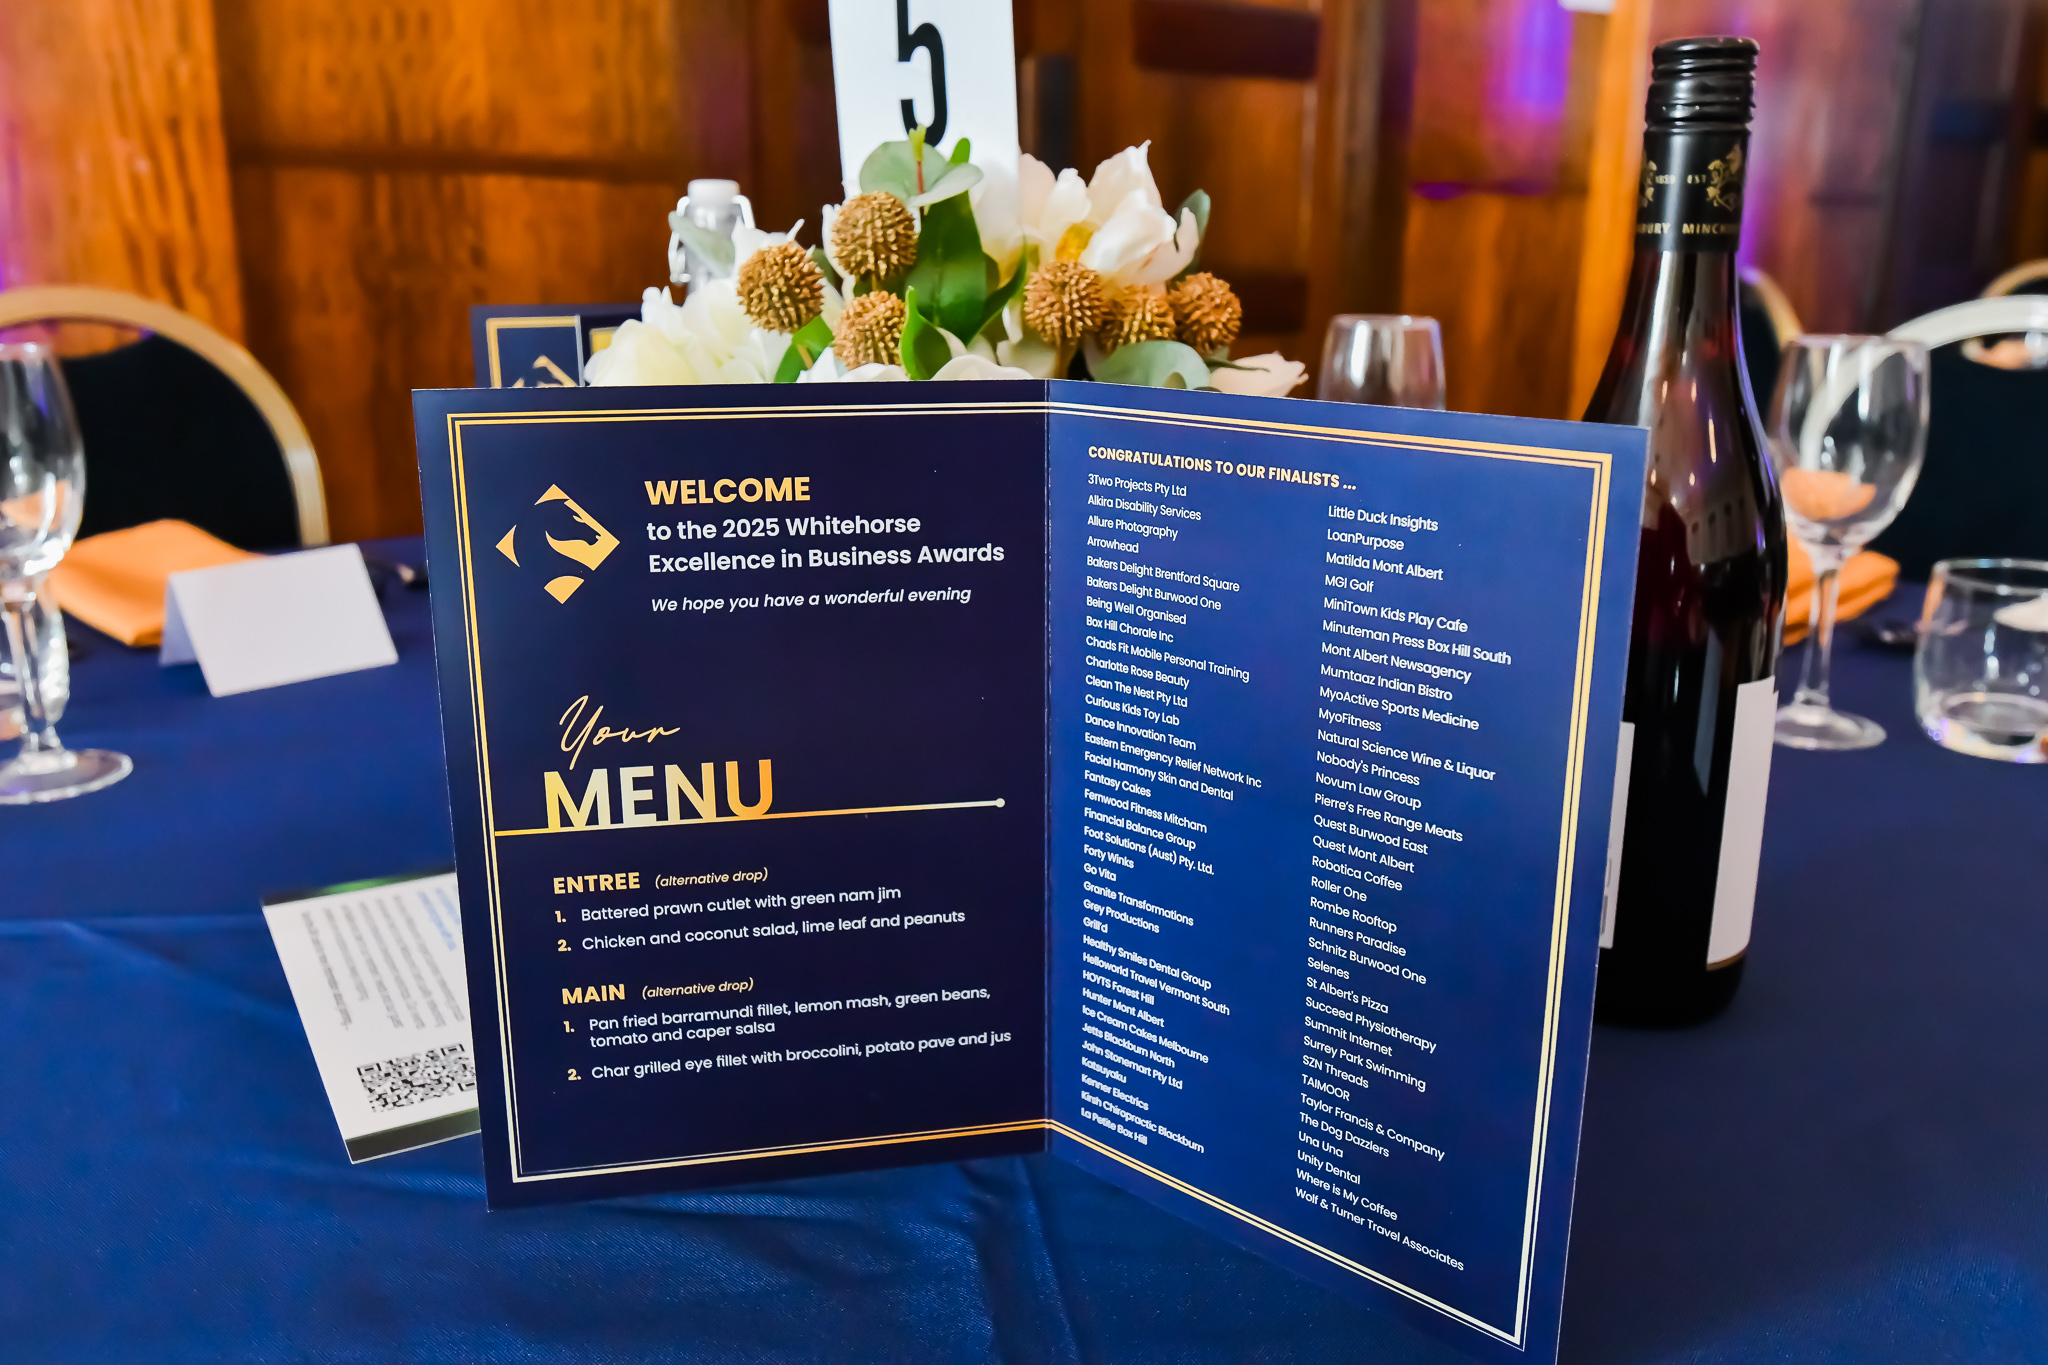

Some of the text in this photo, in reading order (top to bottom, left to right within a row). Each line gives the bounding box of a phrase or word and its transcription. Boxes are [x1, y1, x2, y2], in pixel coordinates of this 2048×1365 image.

[897, 0, 948, 147] 5
[1087, 473, 1187, 497] 3Two Projects Pty Ltd
[1088, 445, 1212, 472] CONGRATULATIONS
[1214, 460, 1233, 475] TO
[1236, 463, 1266, 479] OUR
[1268, 466, 1339, 488] FINALISTS
[644, 476, 810, 505] WELCOME
[646, 515, 921, 541] to the 2025 Whitehorse
[1087, 515, 1178, 542] Allure Photography
[1328, 505, 1438, 532] Little Duck Insights
[649, 542, 1004, 573] Excellence in Business Awards
[1327, 528, 1404, 551] LoanPurpose
[1086, 555, 1240, 592] Bakers Delight Brentford Square
[1326, 551, 1444, 581] Matilda Mont Albert
[651, 586, 971, 613] We hope you have a wonderful evening
[1086, 595, 1186, 625] Being Well Organised
[1323, 596, 1468, 632] MiniTown Kids Play Cafe
[1085, 635, 1249, 683] Chads Fit Mobile Personal Training
[1319, 685, 1479, 730] MyoActive Sports Medicine
[559, 695, 681, 771] Your
[1084, 731, 1262, 788] Eastern Emergency Relief Network Inc
[1317, 728, 1496, 780] Natural Science Wine & Liquor
[544, 759, 773, 831] MENU
[1356, 803, 1381, 820] Free
[1383, 811, 1423, 832] Range
[1424, 822, 1463, 842] Meats
[1083, 825, 1214, 875] Foot Solutions (Aust) Pty. Ltd.
[553, 866, 768, 894] ENTREE (alternative drop)
[554, 886, 901, 923] 1. Battered prawn cutlet with green nam jim
[1083, 880, 1194, 926] Granite Transformations
[1310, 896, 1397, 934] Rombe Rooftop
[557, 911, 965, 952] 2. Chicken and coconut salad, lime leaf and peanuts
[561, 976, 754, 1005] MAIN (alternative drop)
[1082, 951, 1230, 1016] Helloworld Travel Vermont South
[1306, 976, 1317, 989] St
[1361, 995, 1389, 1014] Pizza
[563, 988, 990, 1033] 1. Pan fried barramundi fillet, lemon mash, green beans,
[1305, 996, 1437, 1054] Succeed Physiotherapy
[589, 1021, 775, 1048] tomato and caper salsa
[567, 1031, 1011, 1081] 2. Char grilled eye fillet with broccolini, potato pave and jus
[1303, 1035, 1426, 1093] Surrey Park Swimming
[1300, 1092, 1445, 1161] Taylor Francis & Company
[1295, 1186, 1464, 1271] Wolf & Turner Travel Associates
